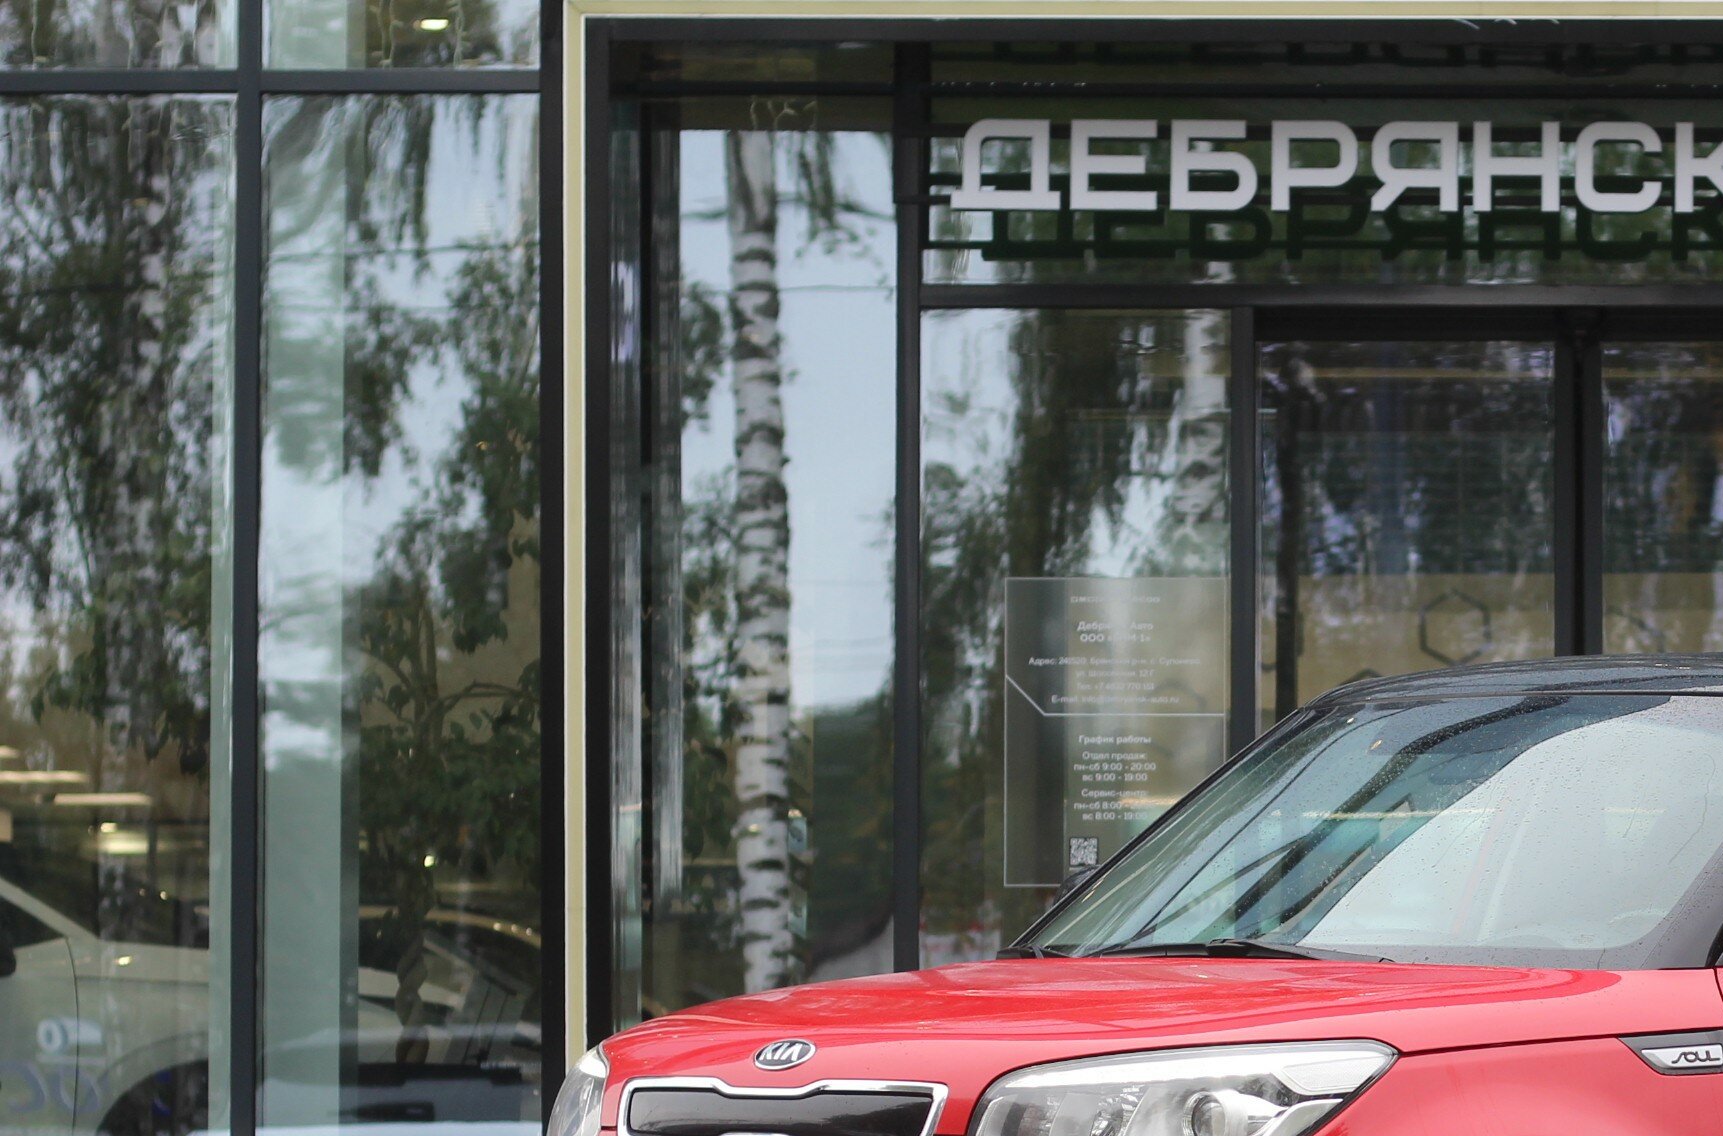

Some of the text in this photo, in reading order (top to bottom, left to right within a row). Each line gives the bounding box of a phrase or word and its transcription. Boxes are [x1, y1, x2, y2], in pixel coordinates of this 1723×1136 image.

[1079, 734, 1152, 745] График работы
[1073, 762, 1100, 771] пн-сб
[1102, 762, 1122, 771] 9:00
[1130, 762, 1157, 771] 20:00
[1095, 773, 1116, 781] 9:00
[758, 1042, 803, 1062] KIA
